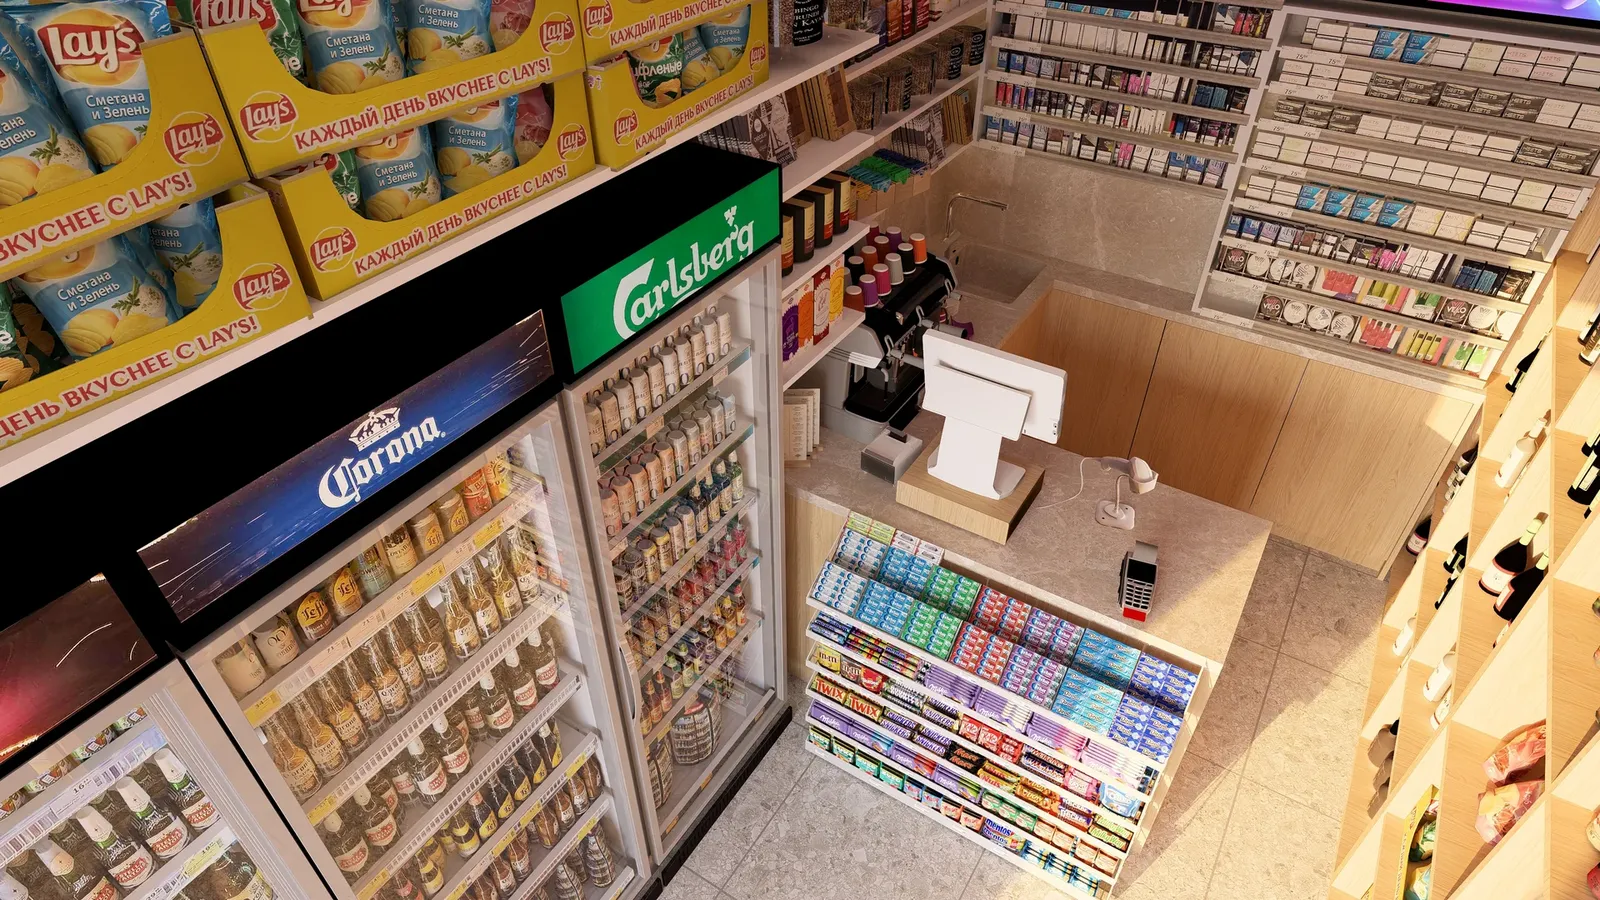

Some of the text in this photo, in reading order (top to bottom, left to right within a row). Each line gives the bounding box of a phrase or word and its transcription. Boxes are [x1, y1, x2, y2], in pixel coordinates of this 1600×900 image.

[418, 5, 459, 18] Сметана
[427, 15, 459, 28] Зелень
[586, 4, 612, 27] Lay's
[794, 11, 820, 21] RUNDI
[326, 33, 371, 48] Сметана
[541, 19, 574, 46] Lay's
[610, 15, 656, 46] КАЖДЫЙ
[658, 10, 683, 28] ДЕНЬ
[712, 28, 740, 36] Сметана
[720, 36, 741, 44] Зелень
[46, 24, 138, 72] Lay's
[330, 44, 375, 59] и Зелень
[86, 92, 145, 107] Сметана
[92, 105, 150, 120] и Зелень
[295, 58, 552, 150] КАЖДЫЙ ДЕНЬ ВКУСНЕЕ С LAY'S!
[635, 120, 674, 149] КАЖДЫЙ
[675, 109, 695, 129] ДЕНЬ
[695, 91, 728, 116] ВКУСНЕЕ
[735, 75, 754, 94] LAY'S!
[243, 97, 294, 129] Lay's
[615, 111, 638, 139] Lay's
[0, 128, 36, 149] елень
[168, 120, 221, 150] Lay's
[448, 126, 487, 138] Сметана
[457, 135, 487, 147] Зелень
[558, 127, 587, 153] Lay's
[375, 160, 414, 177] Сметана
[387, 170, 418, 186] Зелень
[107, 197, 129, 216] С
[128, 171, 193, 209] LAY'S!
[354, 164, 567, 275] КАЖДЫЙ ДЕНЬ ВКУСНЕЕ С LAY'S!
[150, 228, 180, 238] етана
[312, 231, 355, 262] Lay's
[57, 270, 112, 302] Сметана
[236, 271, 288, 300] Lay's
[613, 220, 755, 341] Carlsberg
[67, 281, 121, 312] и Зелень
[63, 351, 173, 409] ВКУСНЕЕ
[176, 343, 194, 360] С
[197, 315, 258, 354] LAY'S!
[318, 416, 441, 509] Corona
[986, 818, 1012, 836] mentos
